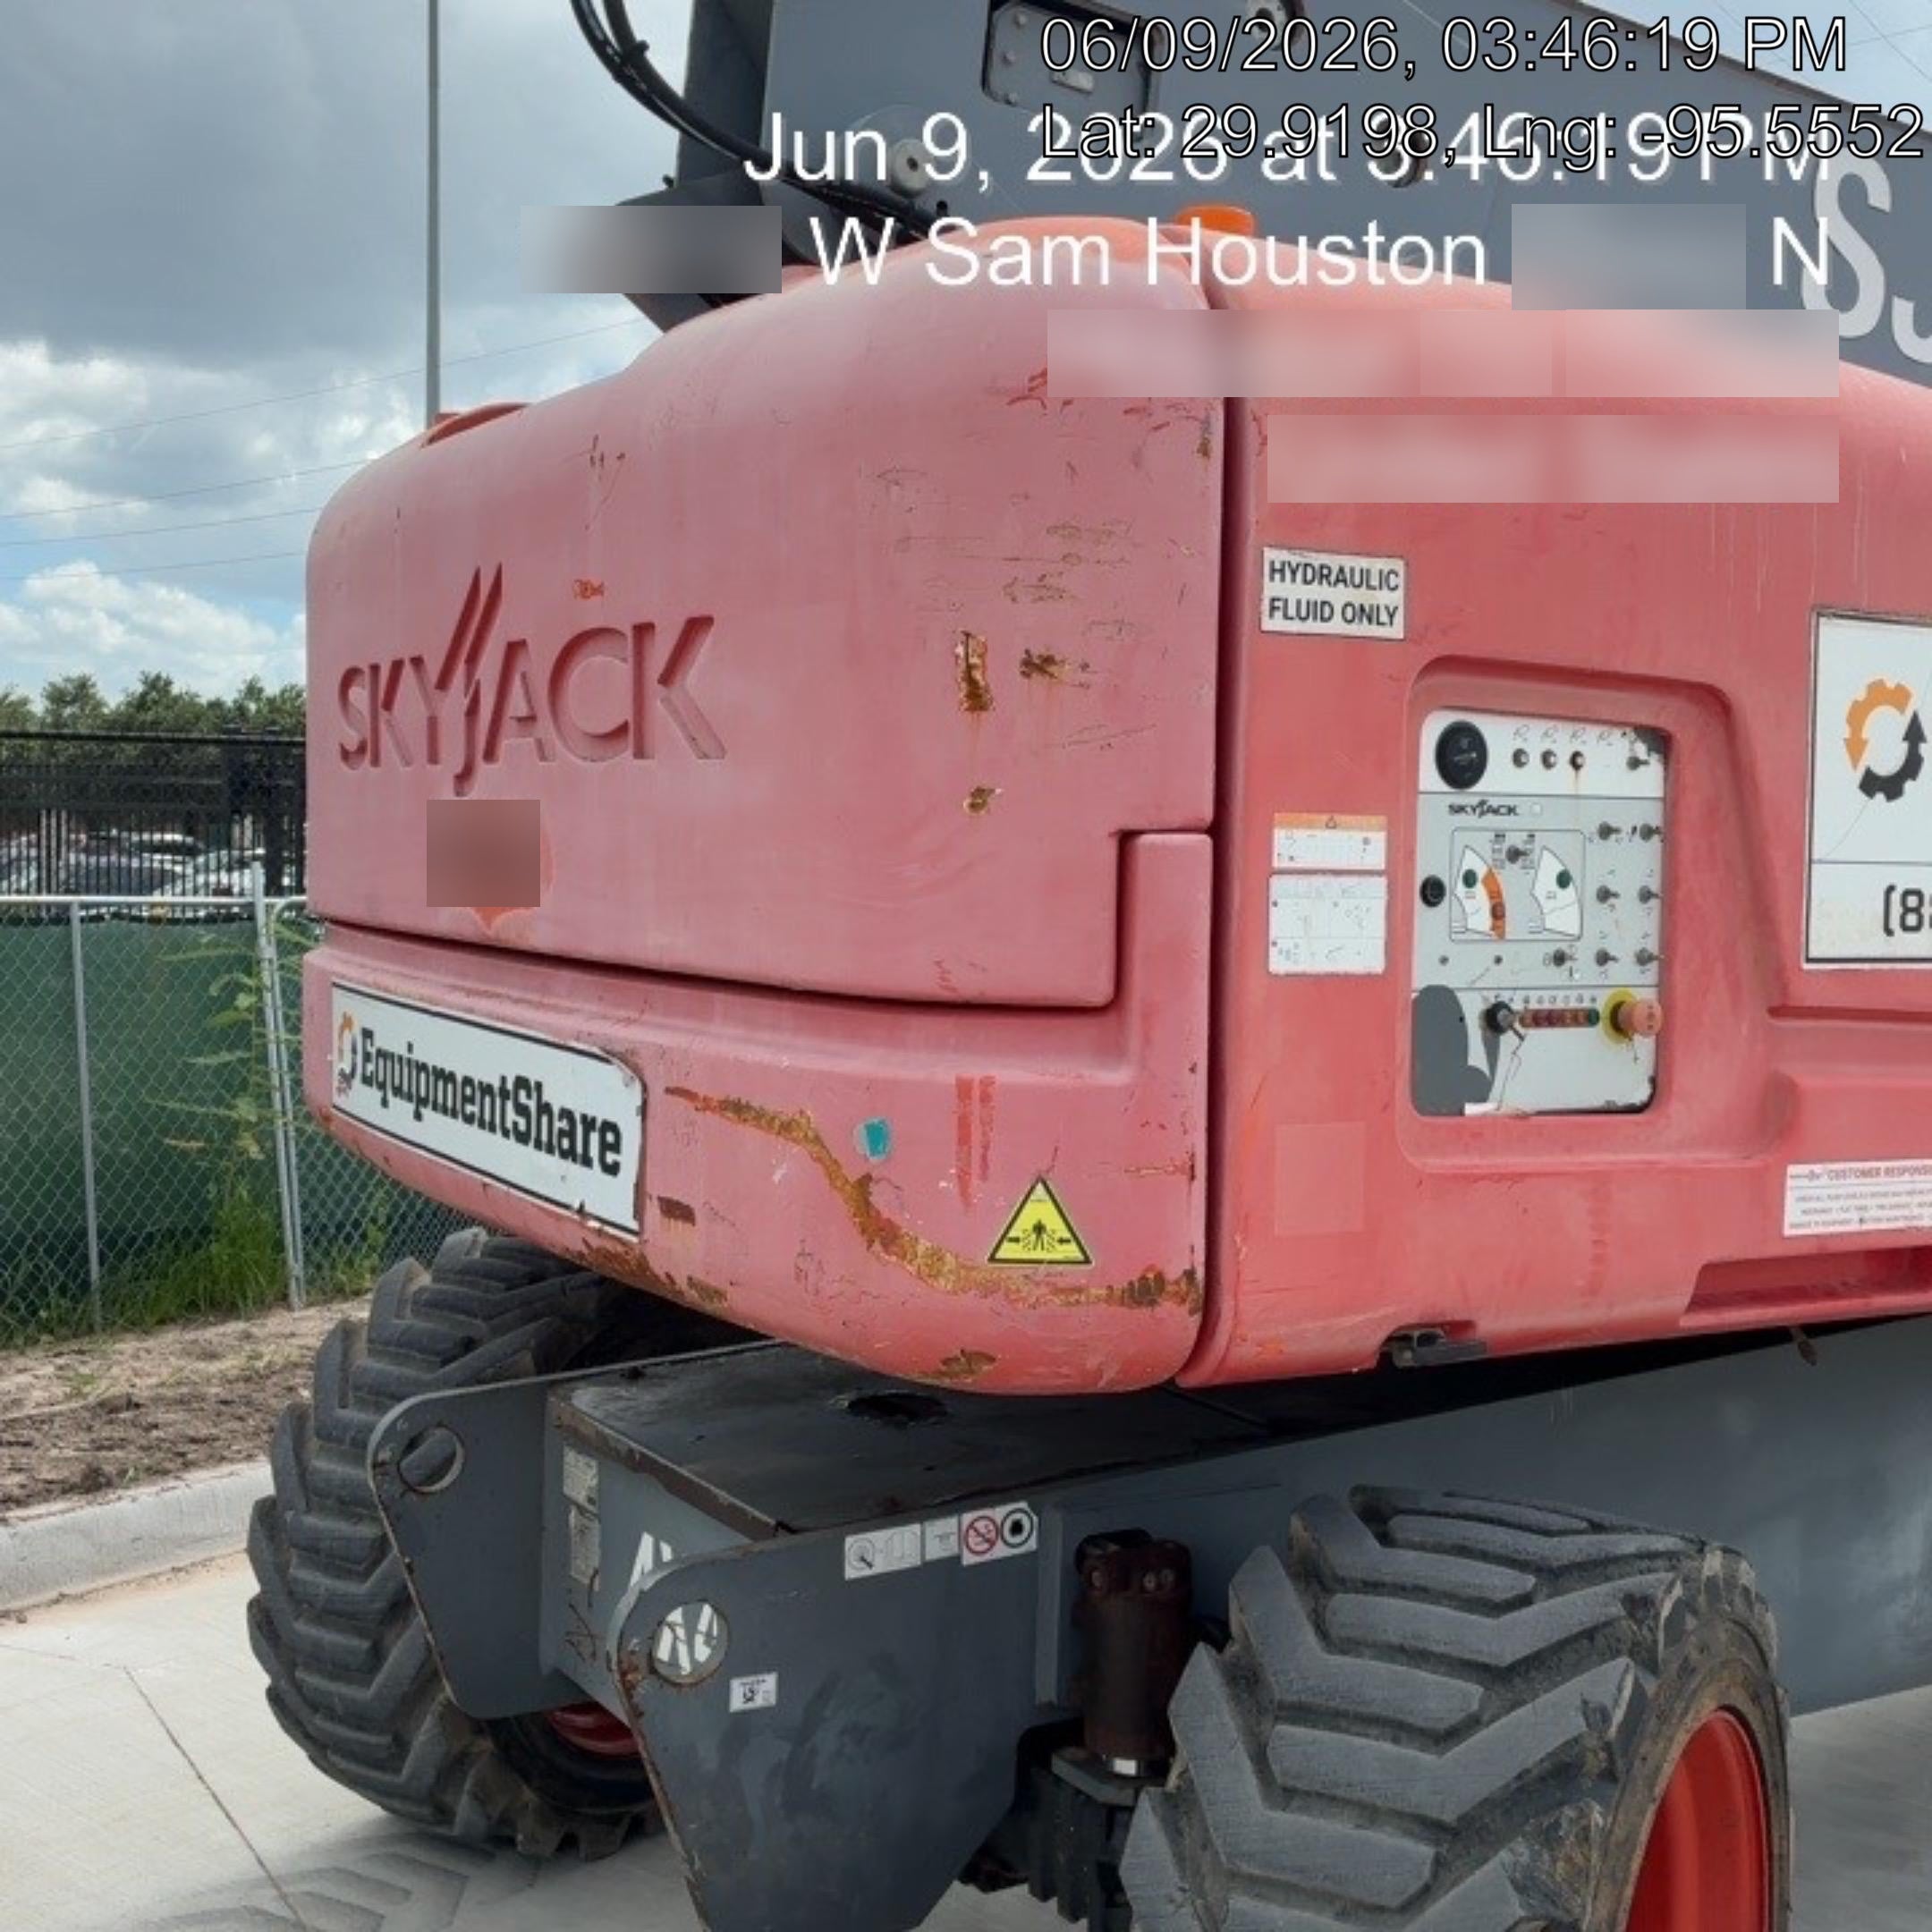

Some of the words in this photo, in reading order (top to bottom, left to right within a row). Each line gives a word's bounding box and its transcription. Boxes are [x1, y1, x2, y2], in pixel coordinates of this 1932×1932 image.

[1269, 560, 1400, 591] HYDRAULIC
[1268, 597, 1335, 623] FLUID
[1341, 601, 1399, 628] ONLY
[337, 562, 726, 797] SKYJACK
[1883, 885, 1932, 937] (8
[360, 1027, 623, 1178] EquipmentShare
